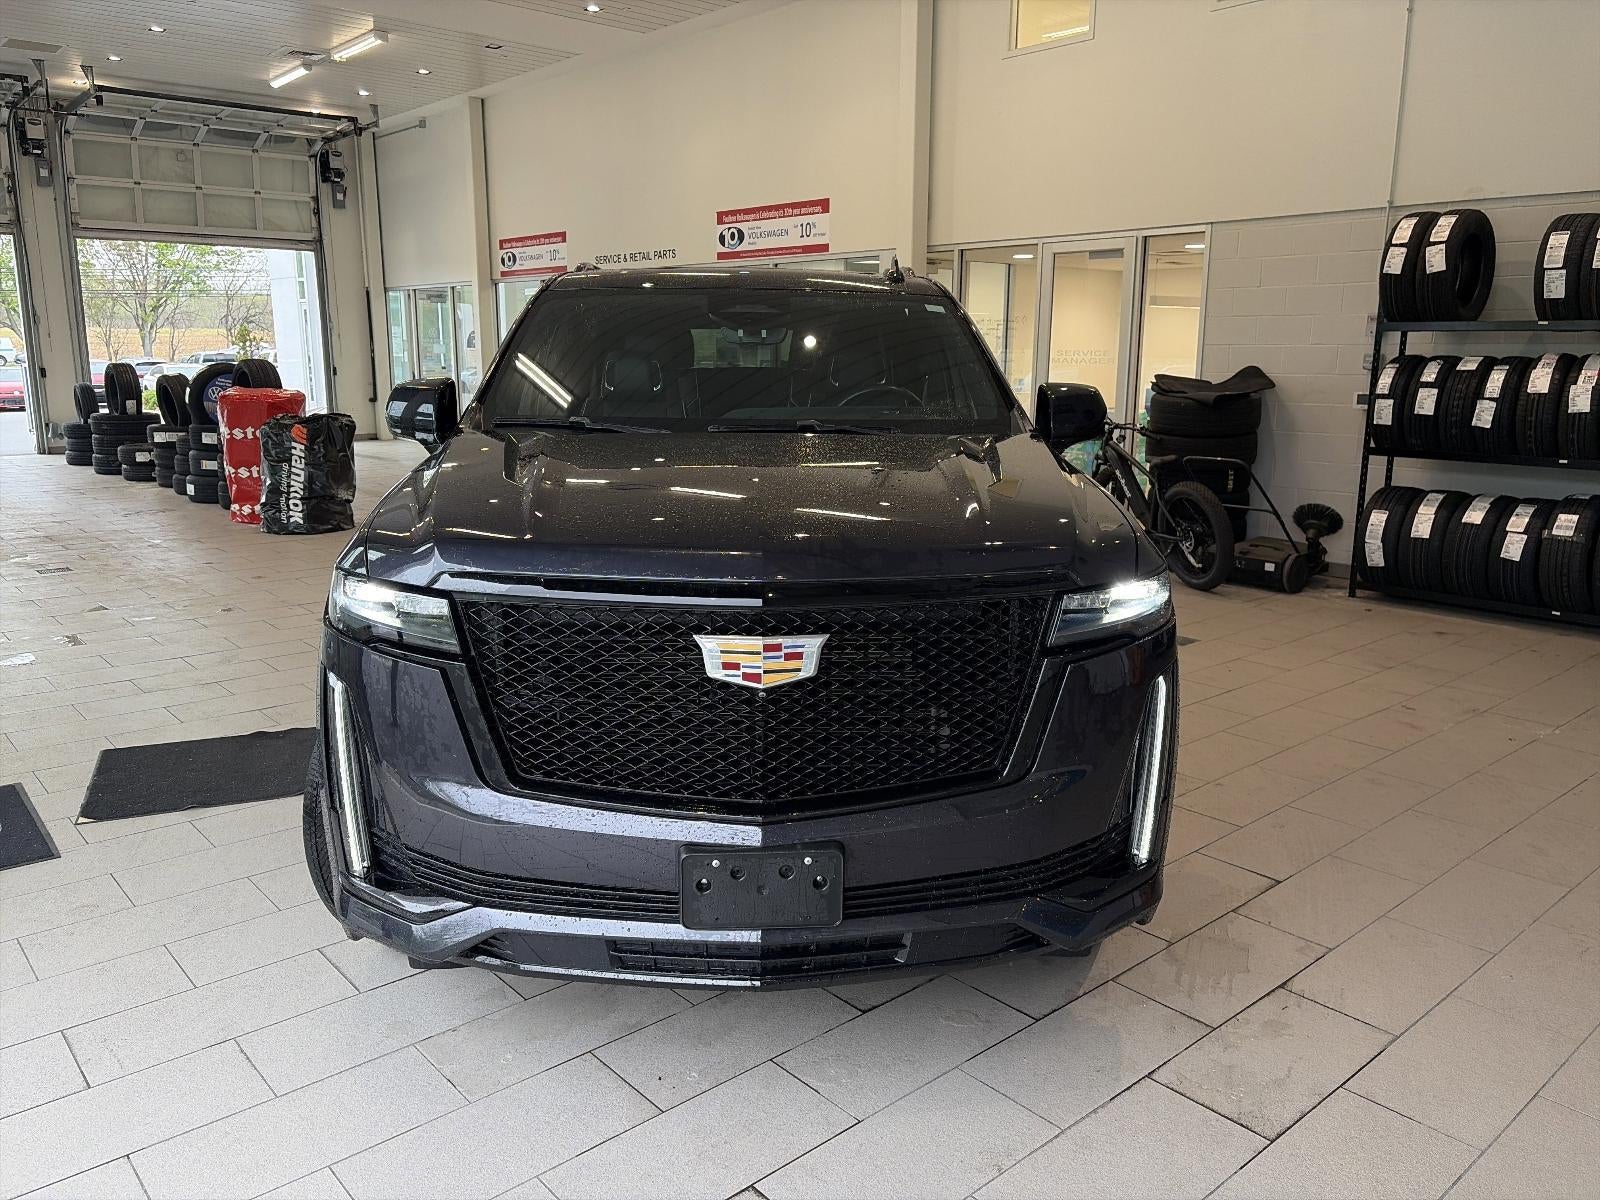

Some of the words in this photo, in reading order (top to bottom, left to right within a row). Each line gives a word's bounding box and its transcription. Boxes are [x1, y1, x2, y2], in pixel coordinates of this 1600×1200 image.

[748, 228, 789, 240] VOLKSWAGEN
[594, 254, 622, 264] SERVICE
[622, 254, 628, 262] &
[630, 252, 652, 262] RETAIL
[654, 248, 676, 260] PARTS
[1056, 349, 1110, 357] SERVICE
[1052, 357, 1114, 365] MANAGER
[280, 462, 288, 492] driving
